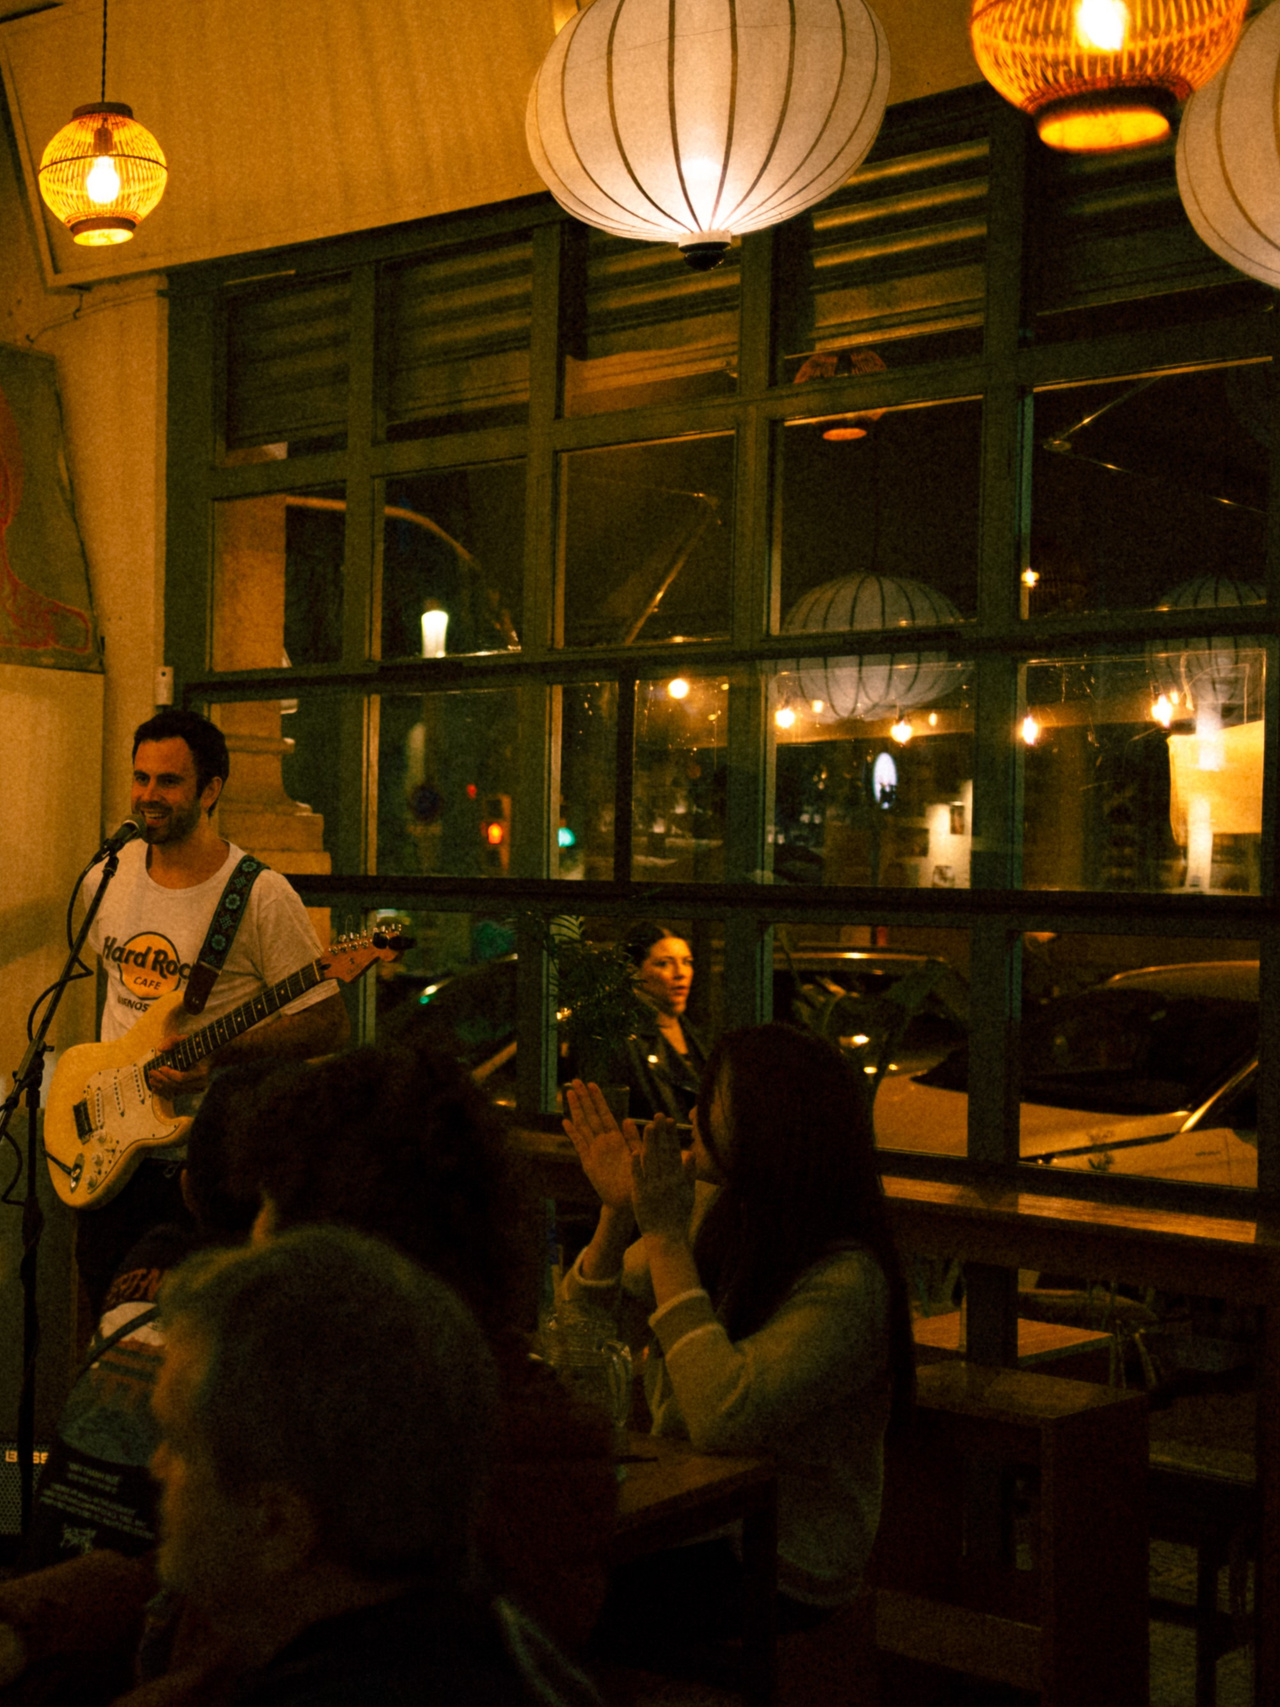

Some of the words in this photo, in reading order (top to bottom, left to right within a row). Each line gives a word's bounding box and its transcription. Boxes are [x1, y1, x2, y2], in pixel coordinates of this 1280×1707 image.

[102, 935, 152, 969] Hard
[150, 948, 193, 980] Roc
[133, 976, 162, 990] CAFE
[5, 1450, 49, 1464] BSS
